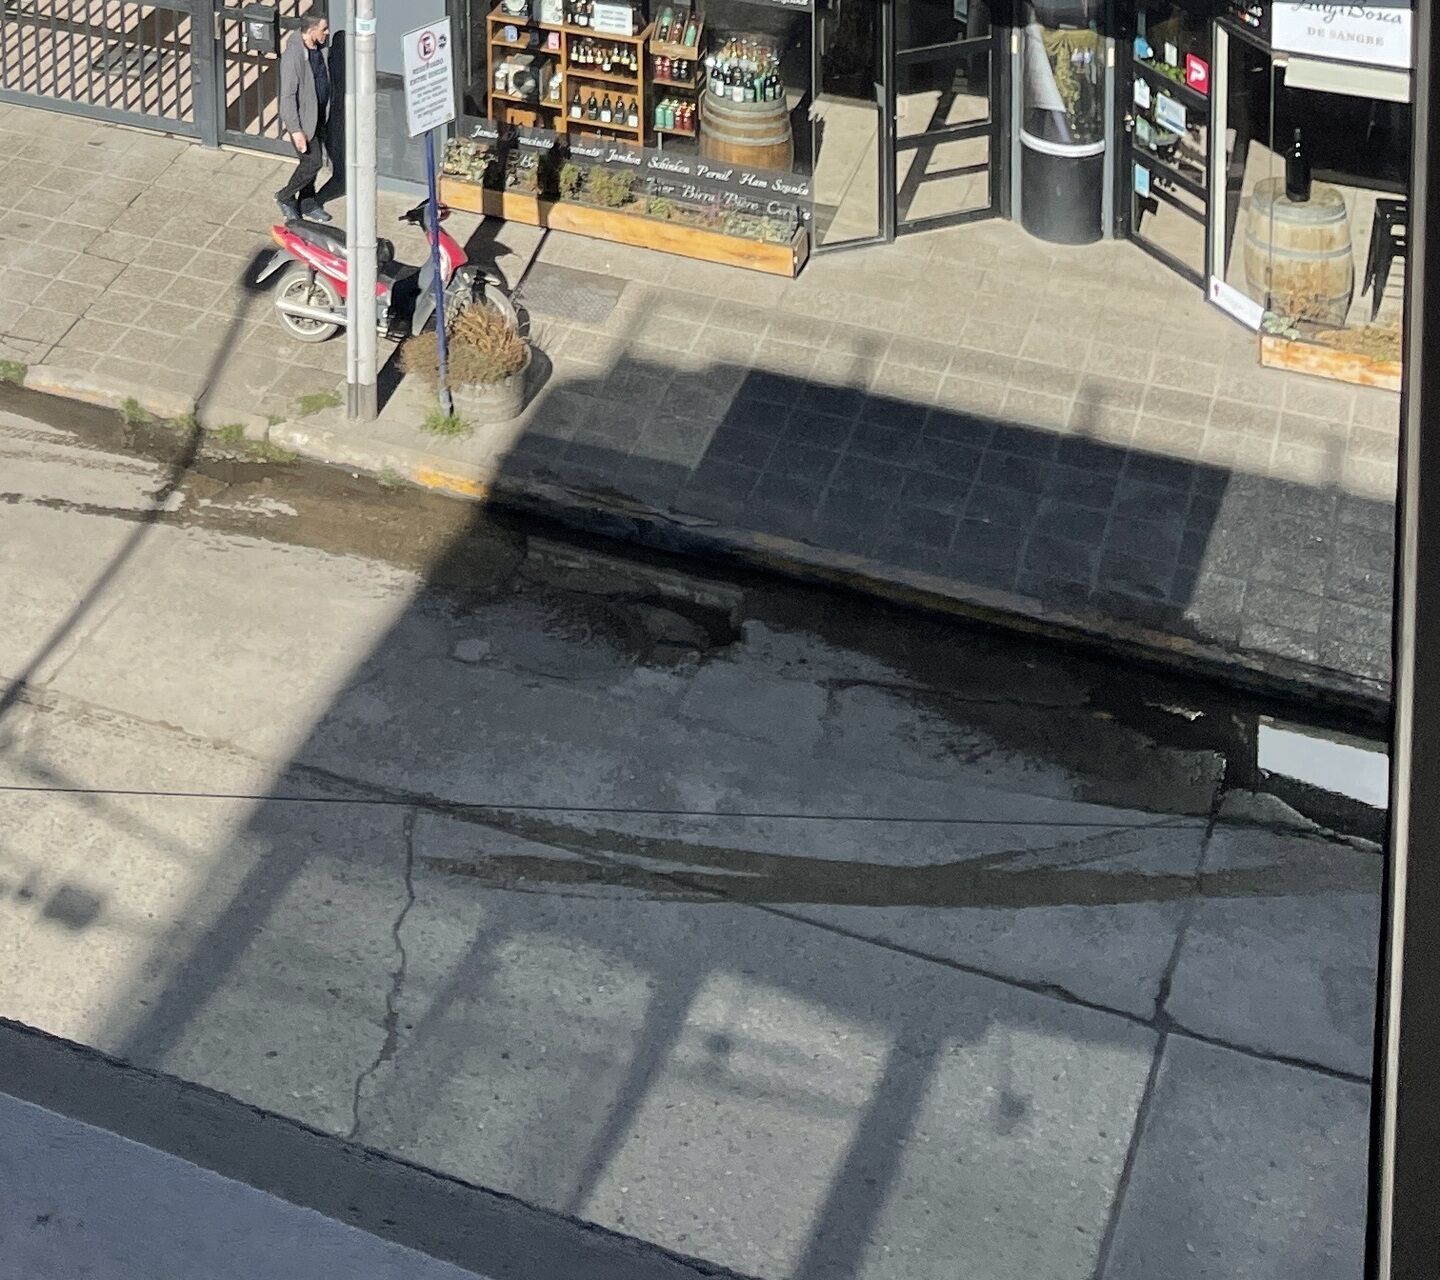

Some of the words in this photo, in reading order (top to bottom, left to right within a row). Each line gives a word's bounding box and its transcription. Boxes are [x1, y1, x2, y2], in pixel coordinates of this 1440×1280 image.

[1307, 26, 1326, 38] DE
[1328, 28, 1385, 47] SANGRE
[605, 148, 642, 165] Jambon
[647, 156, 691, 175] Schinken
[696, 164, 733, 182] Pernil
[738, 172, 768, 189] Ham
[771, 178, 810, 196] Szynka
